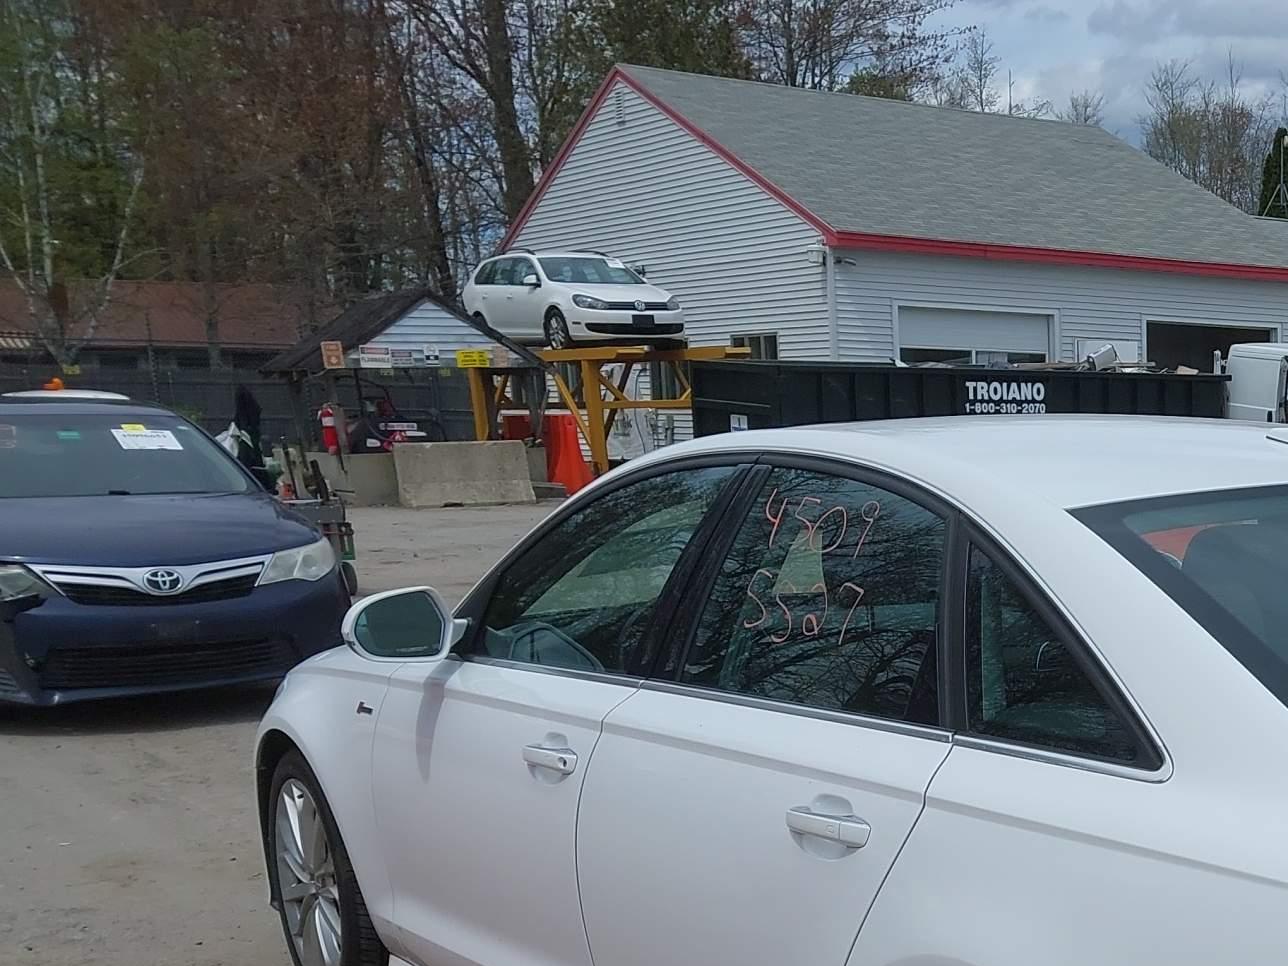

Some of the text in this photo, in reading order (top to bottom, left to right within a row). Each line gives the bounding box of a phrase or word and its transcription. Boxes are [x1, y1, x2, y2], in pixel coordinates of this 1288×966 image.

[965, 381, 1045, 401] TROIANO
[965, 402, 1046, 414] 1-800-310-2070
[766, 488, 880, 560] 4509
[744, 569, 865, 645] 5527
